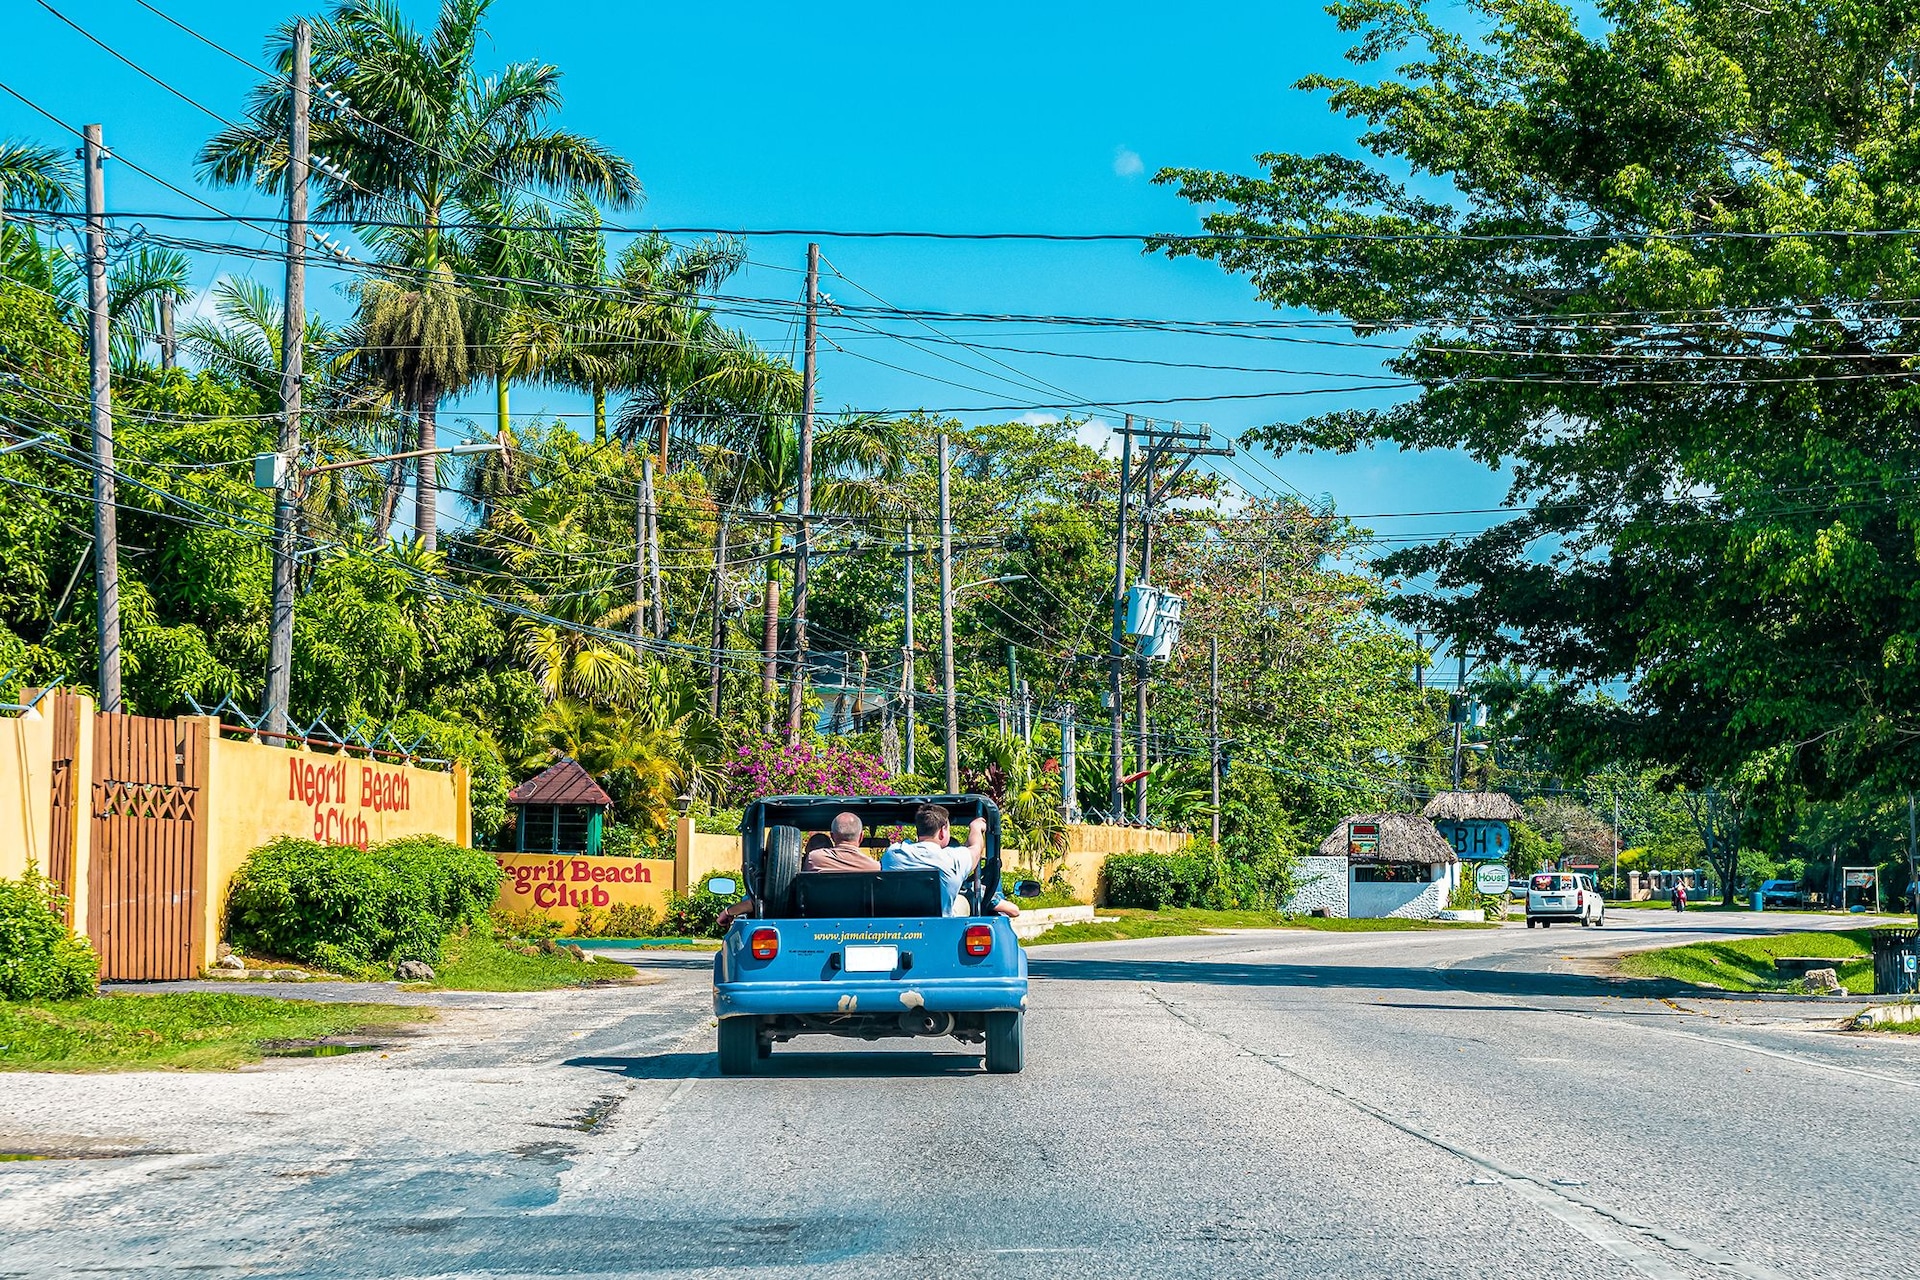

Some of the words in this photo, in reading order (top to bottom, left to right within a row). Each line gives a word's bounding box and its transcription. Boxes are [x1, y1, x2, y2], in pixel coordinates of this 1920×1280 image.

[289, 757, 347, 842] Negril
[361, 765, 410, 813] Beach
[325, 807, 368, 852] Club
[497, 859, 565, 894] egril
[571, 860, 651, 883] Beach
[534, 883, 610, 908] Club
[813, 930, 923, 944] www.jamaicapirat.com
